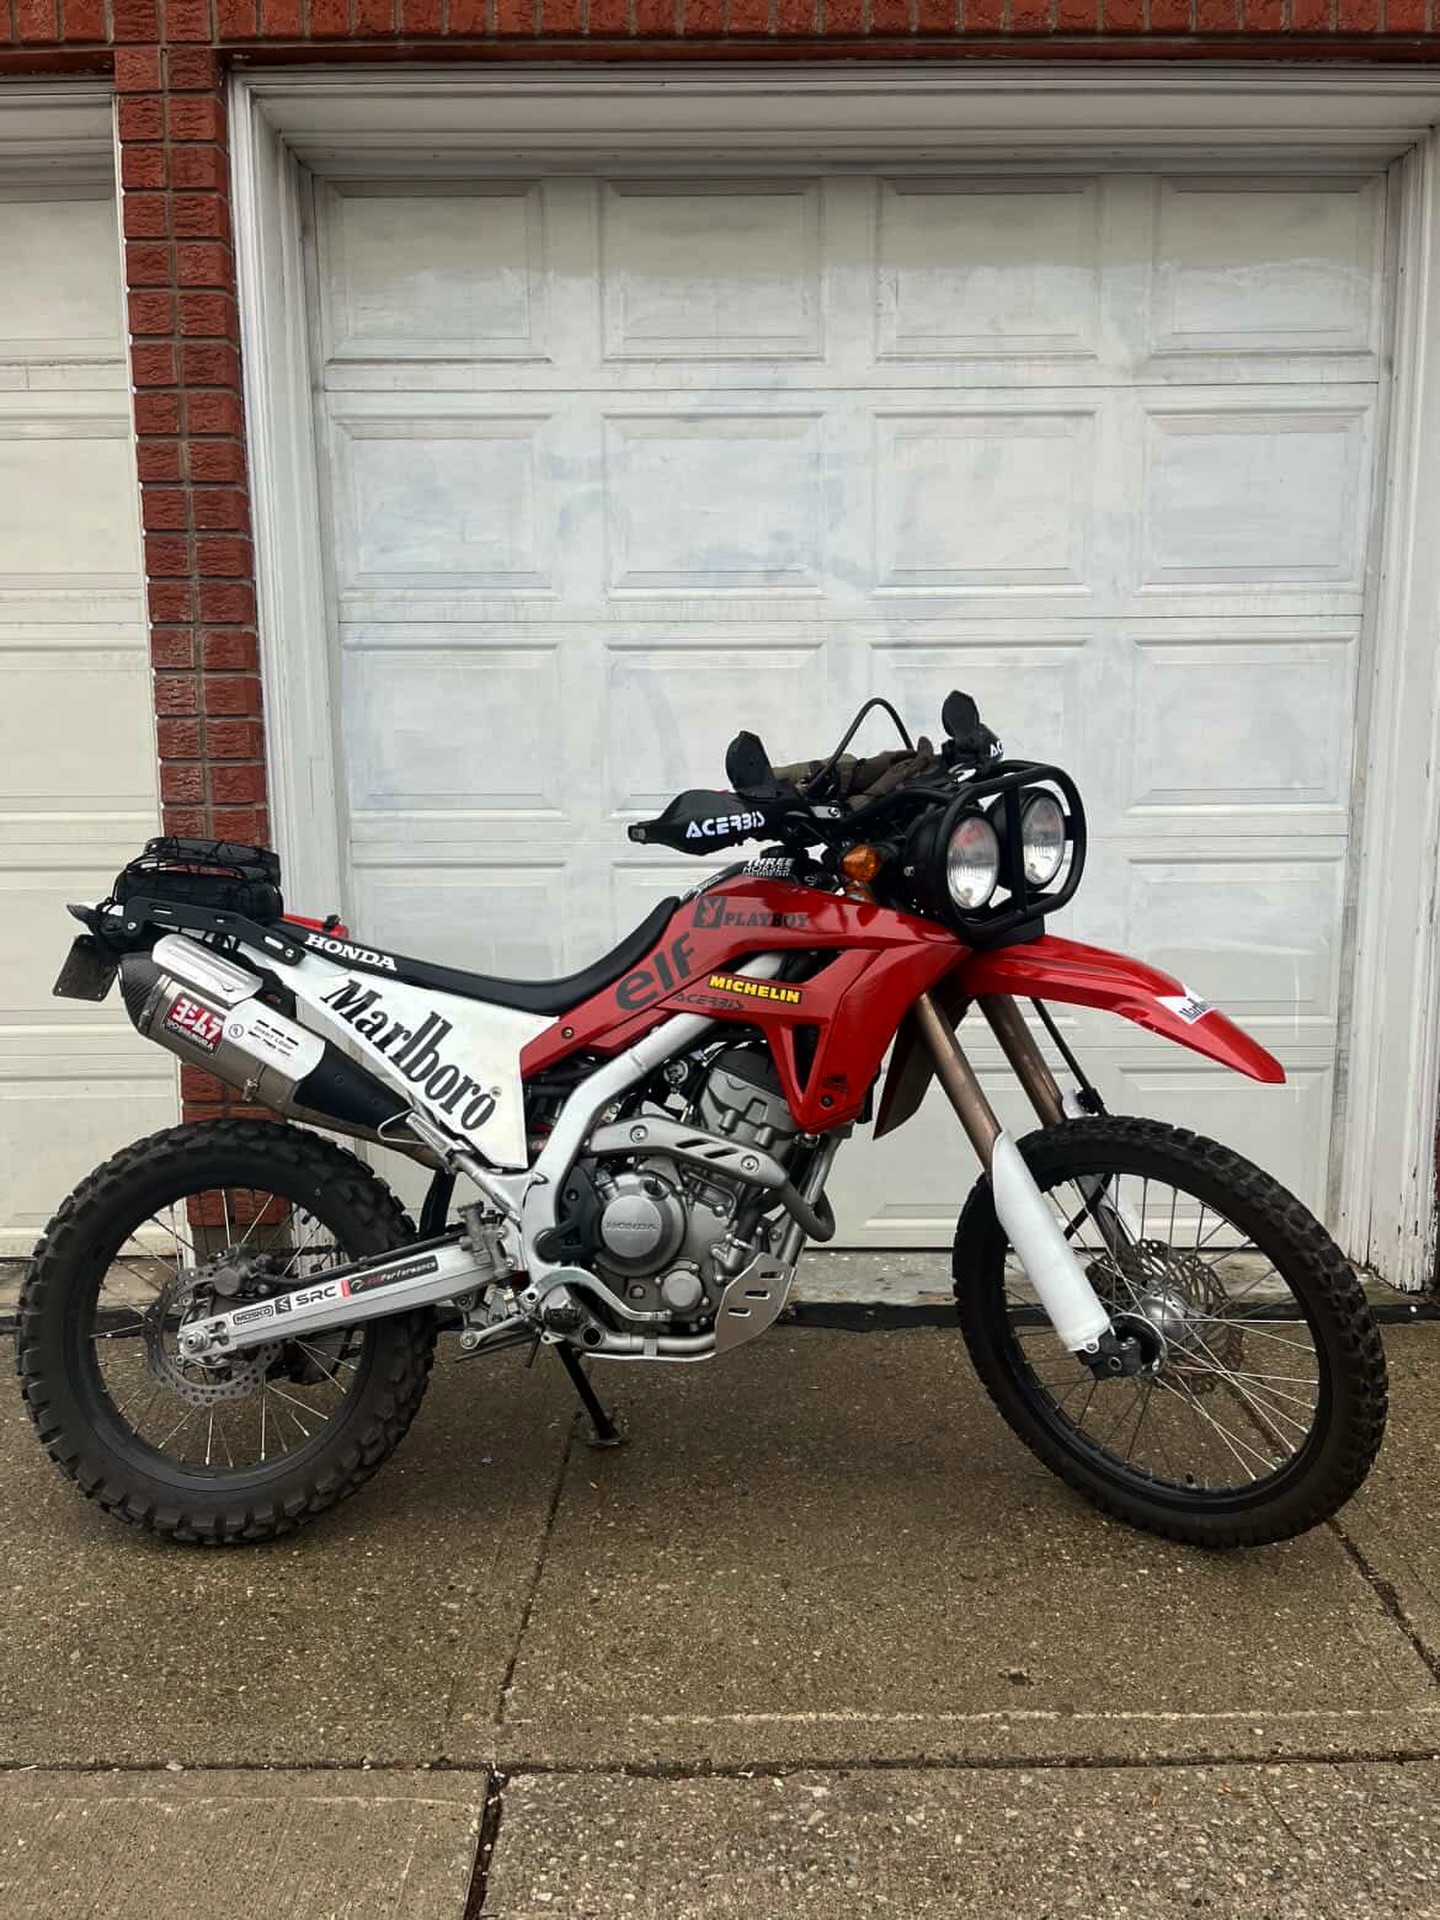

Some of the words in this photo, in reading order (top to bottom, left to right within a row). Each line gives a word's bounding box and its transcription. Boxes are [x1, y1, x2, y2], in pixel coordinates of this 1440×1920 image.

[686, 810, 765, 838] ACERBIS
[723, 912, 809, 927] PLAYBOY
[304, 933, 398, 972] HONDA
[615, 931, 695, 1010] elf
[709, 975, 801, 1004] MICHELIN
[320, 978, 497, 1130] Marlboro
[295, 1285, 338, 1306] SRC
